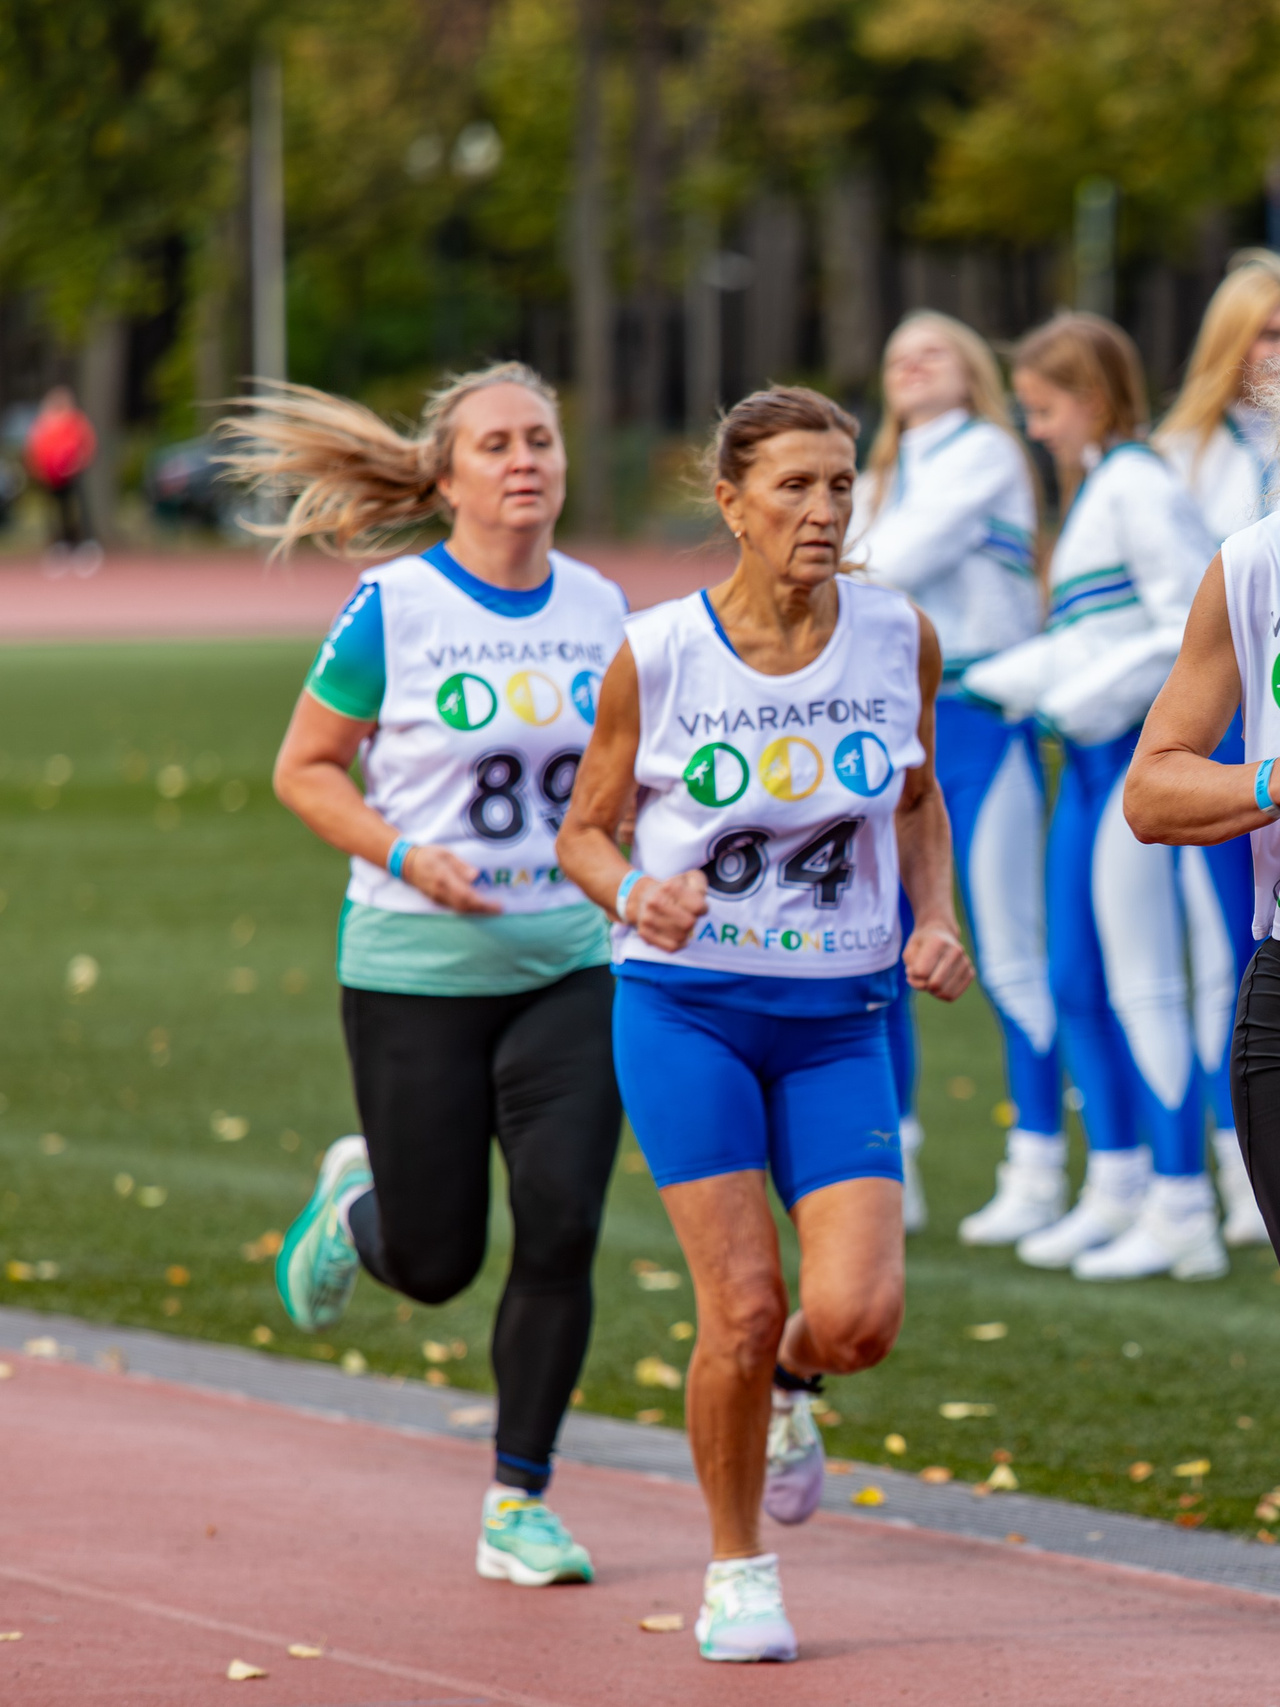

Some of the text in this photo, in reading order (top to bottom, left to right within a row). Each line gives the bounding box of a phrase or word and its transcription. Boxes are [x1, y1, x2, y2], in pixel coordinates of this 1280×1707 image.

[425, 640, 605, 668] VMARAFONE
[678, 699, 887, 737] VMARAFONE
[464, 749, 588, 846] 89
[696, 921, 892, 953] ARAFONE.CLUB
